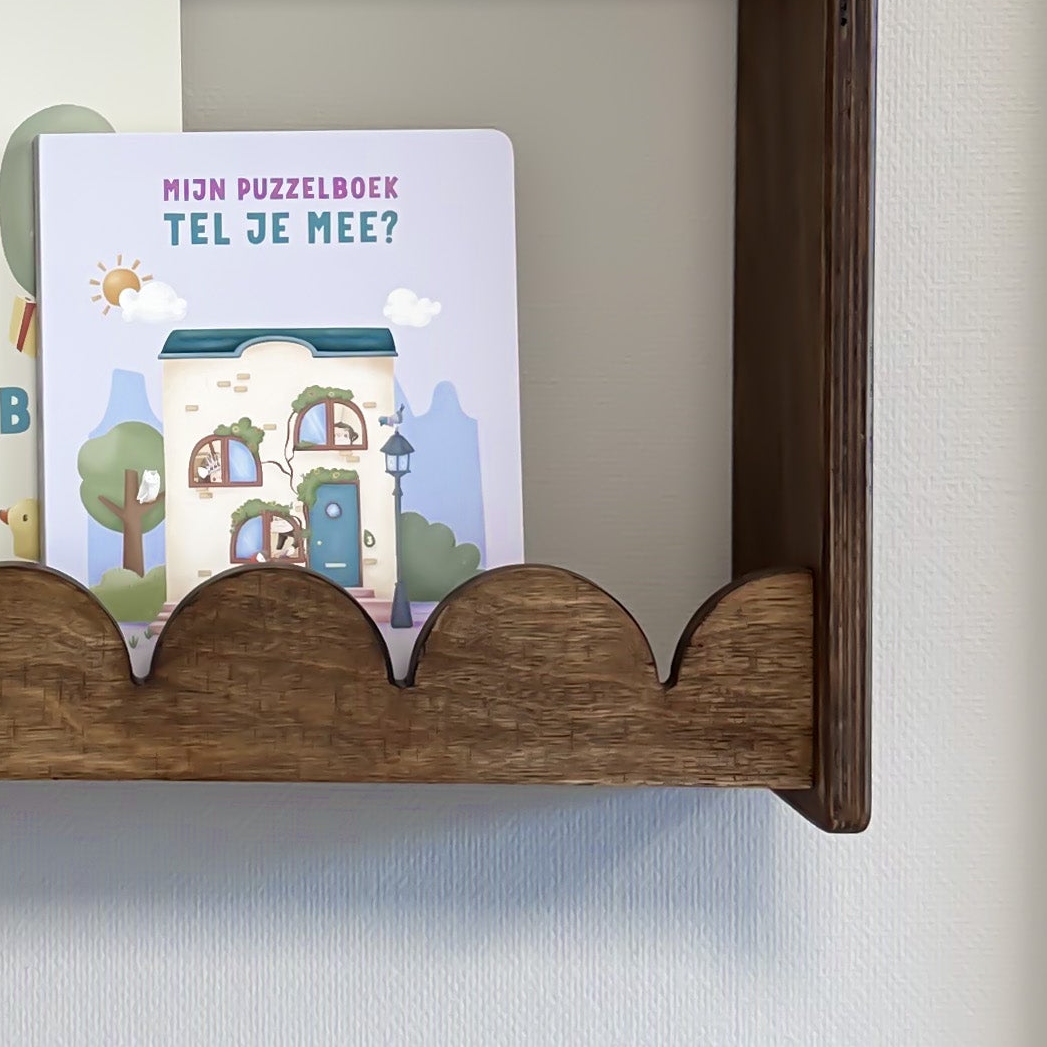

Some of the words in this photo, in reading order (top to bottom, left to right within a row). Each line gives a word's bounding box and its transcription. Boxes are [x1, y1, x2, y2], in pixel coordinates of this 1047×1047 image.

[163, 178, 226, 201] MIJN
[237, 175, 400, 201] PUZZELBOEK
[163, 212, 231, 246] TEL
[246, 211, 290, 245] JE
[307, 209, 400, 244] MEE?
